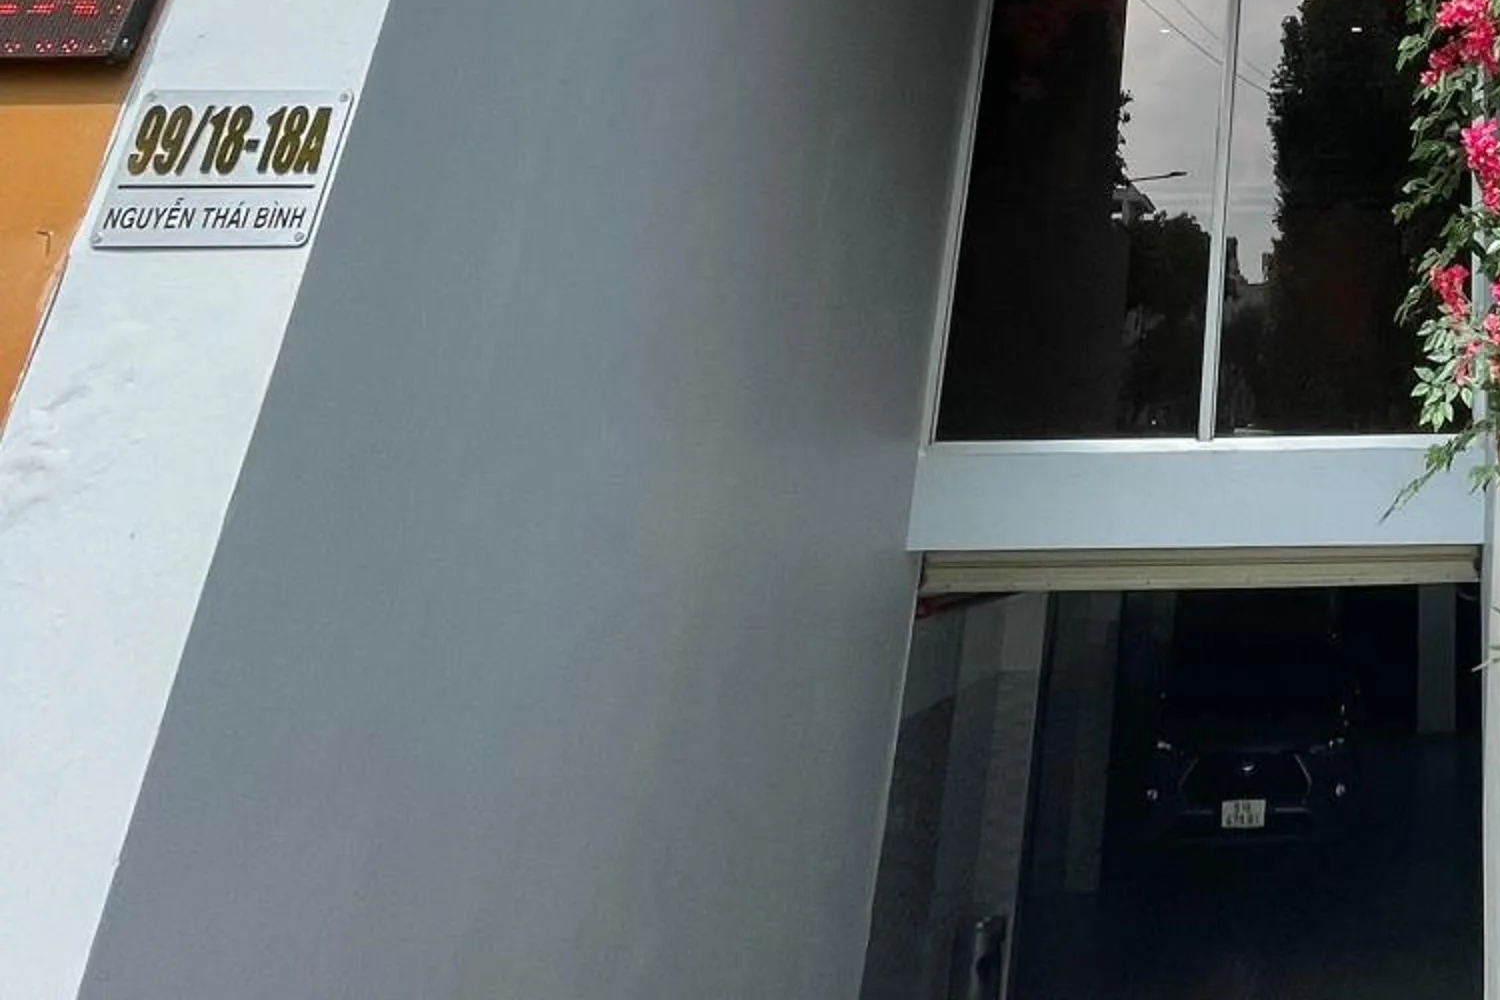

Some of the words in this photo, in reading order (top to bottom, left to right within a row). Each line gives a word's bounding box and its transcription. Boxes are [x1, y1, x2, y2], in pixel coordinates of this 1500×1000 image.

[127, 105, 333, 176] 99/18-18A
[103, 196, 195, 230] NGUYỄN
[202, 200, 250, 230] THÁI
[253, 200, 306, 230] BÌNH
